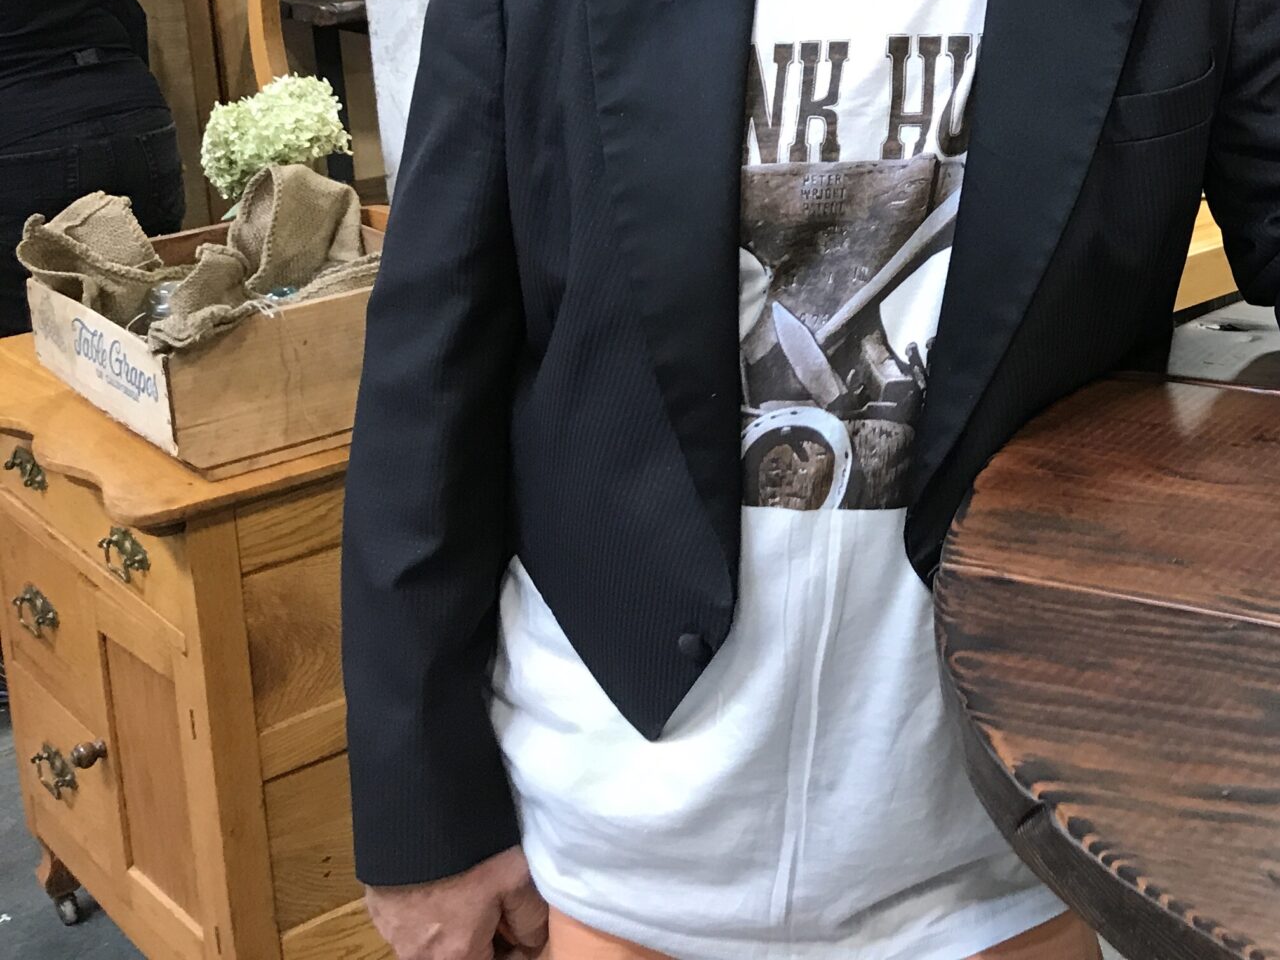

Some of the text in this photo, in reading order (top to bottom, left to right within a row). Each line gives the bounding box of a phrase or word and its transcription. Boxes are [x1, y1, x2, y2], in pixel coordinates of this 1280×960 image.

[803, 174, 842, 186] PETER
[801, 188, 845, 199] WRIGHT
[71, 317, 107, 369] Table
